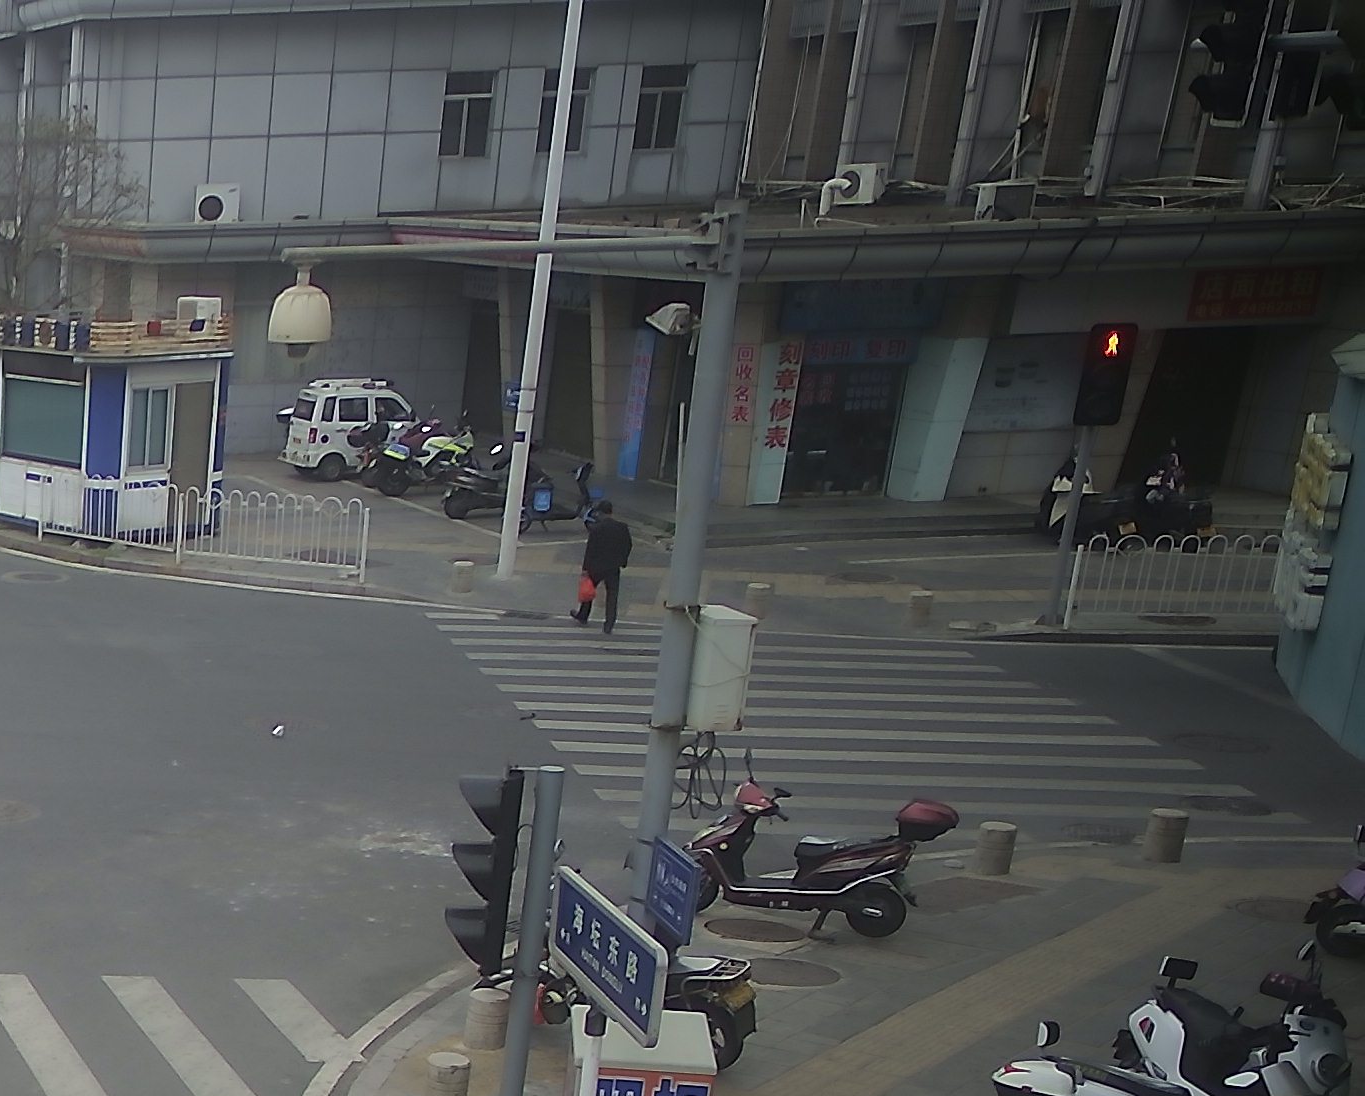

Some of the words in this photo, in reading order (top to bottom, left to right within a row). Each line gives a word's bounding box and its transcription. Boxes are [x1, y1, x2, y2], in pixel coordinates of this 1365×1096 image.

[731, 345, 754, 423] 回收名表
[764, 341, 803, 449] 刻章修表
[572, 903, 638, 985] 海坛东路
